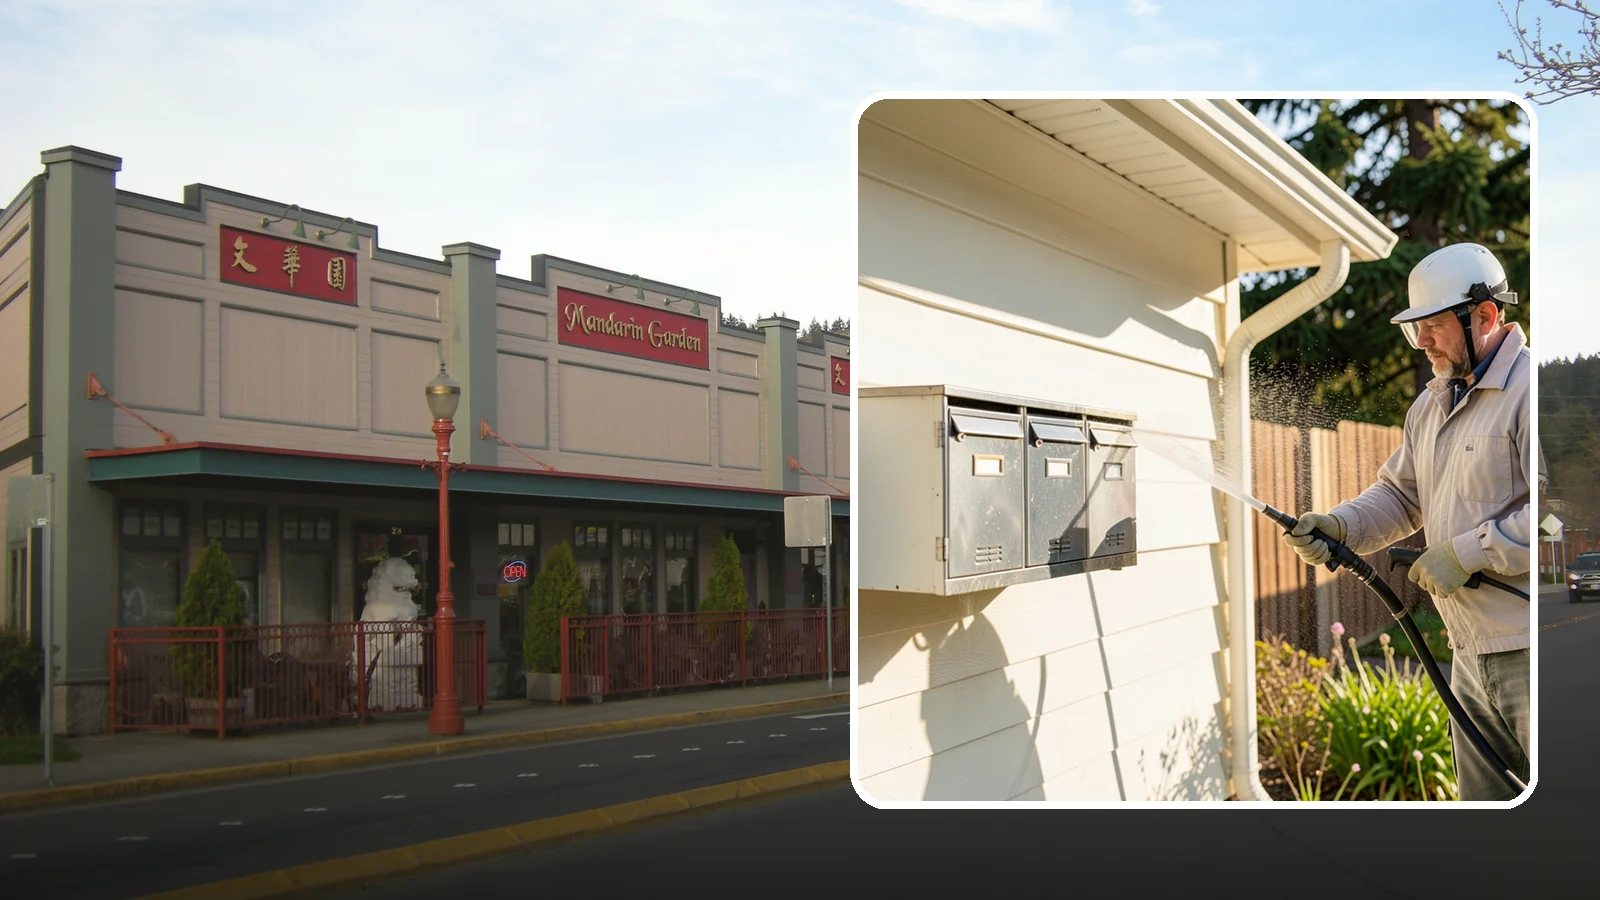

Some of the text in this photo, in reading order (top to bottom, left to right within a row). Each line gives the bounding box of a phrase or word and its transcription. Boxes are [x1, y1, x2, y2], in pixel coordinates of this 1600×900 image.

[564, 302, 702, 352] Mandarin Garden
[503, 565, 526, 577] OPEN
